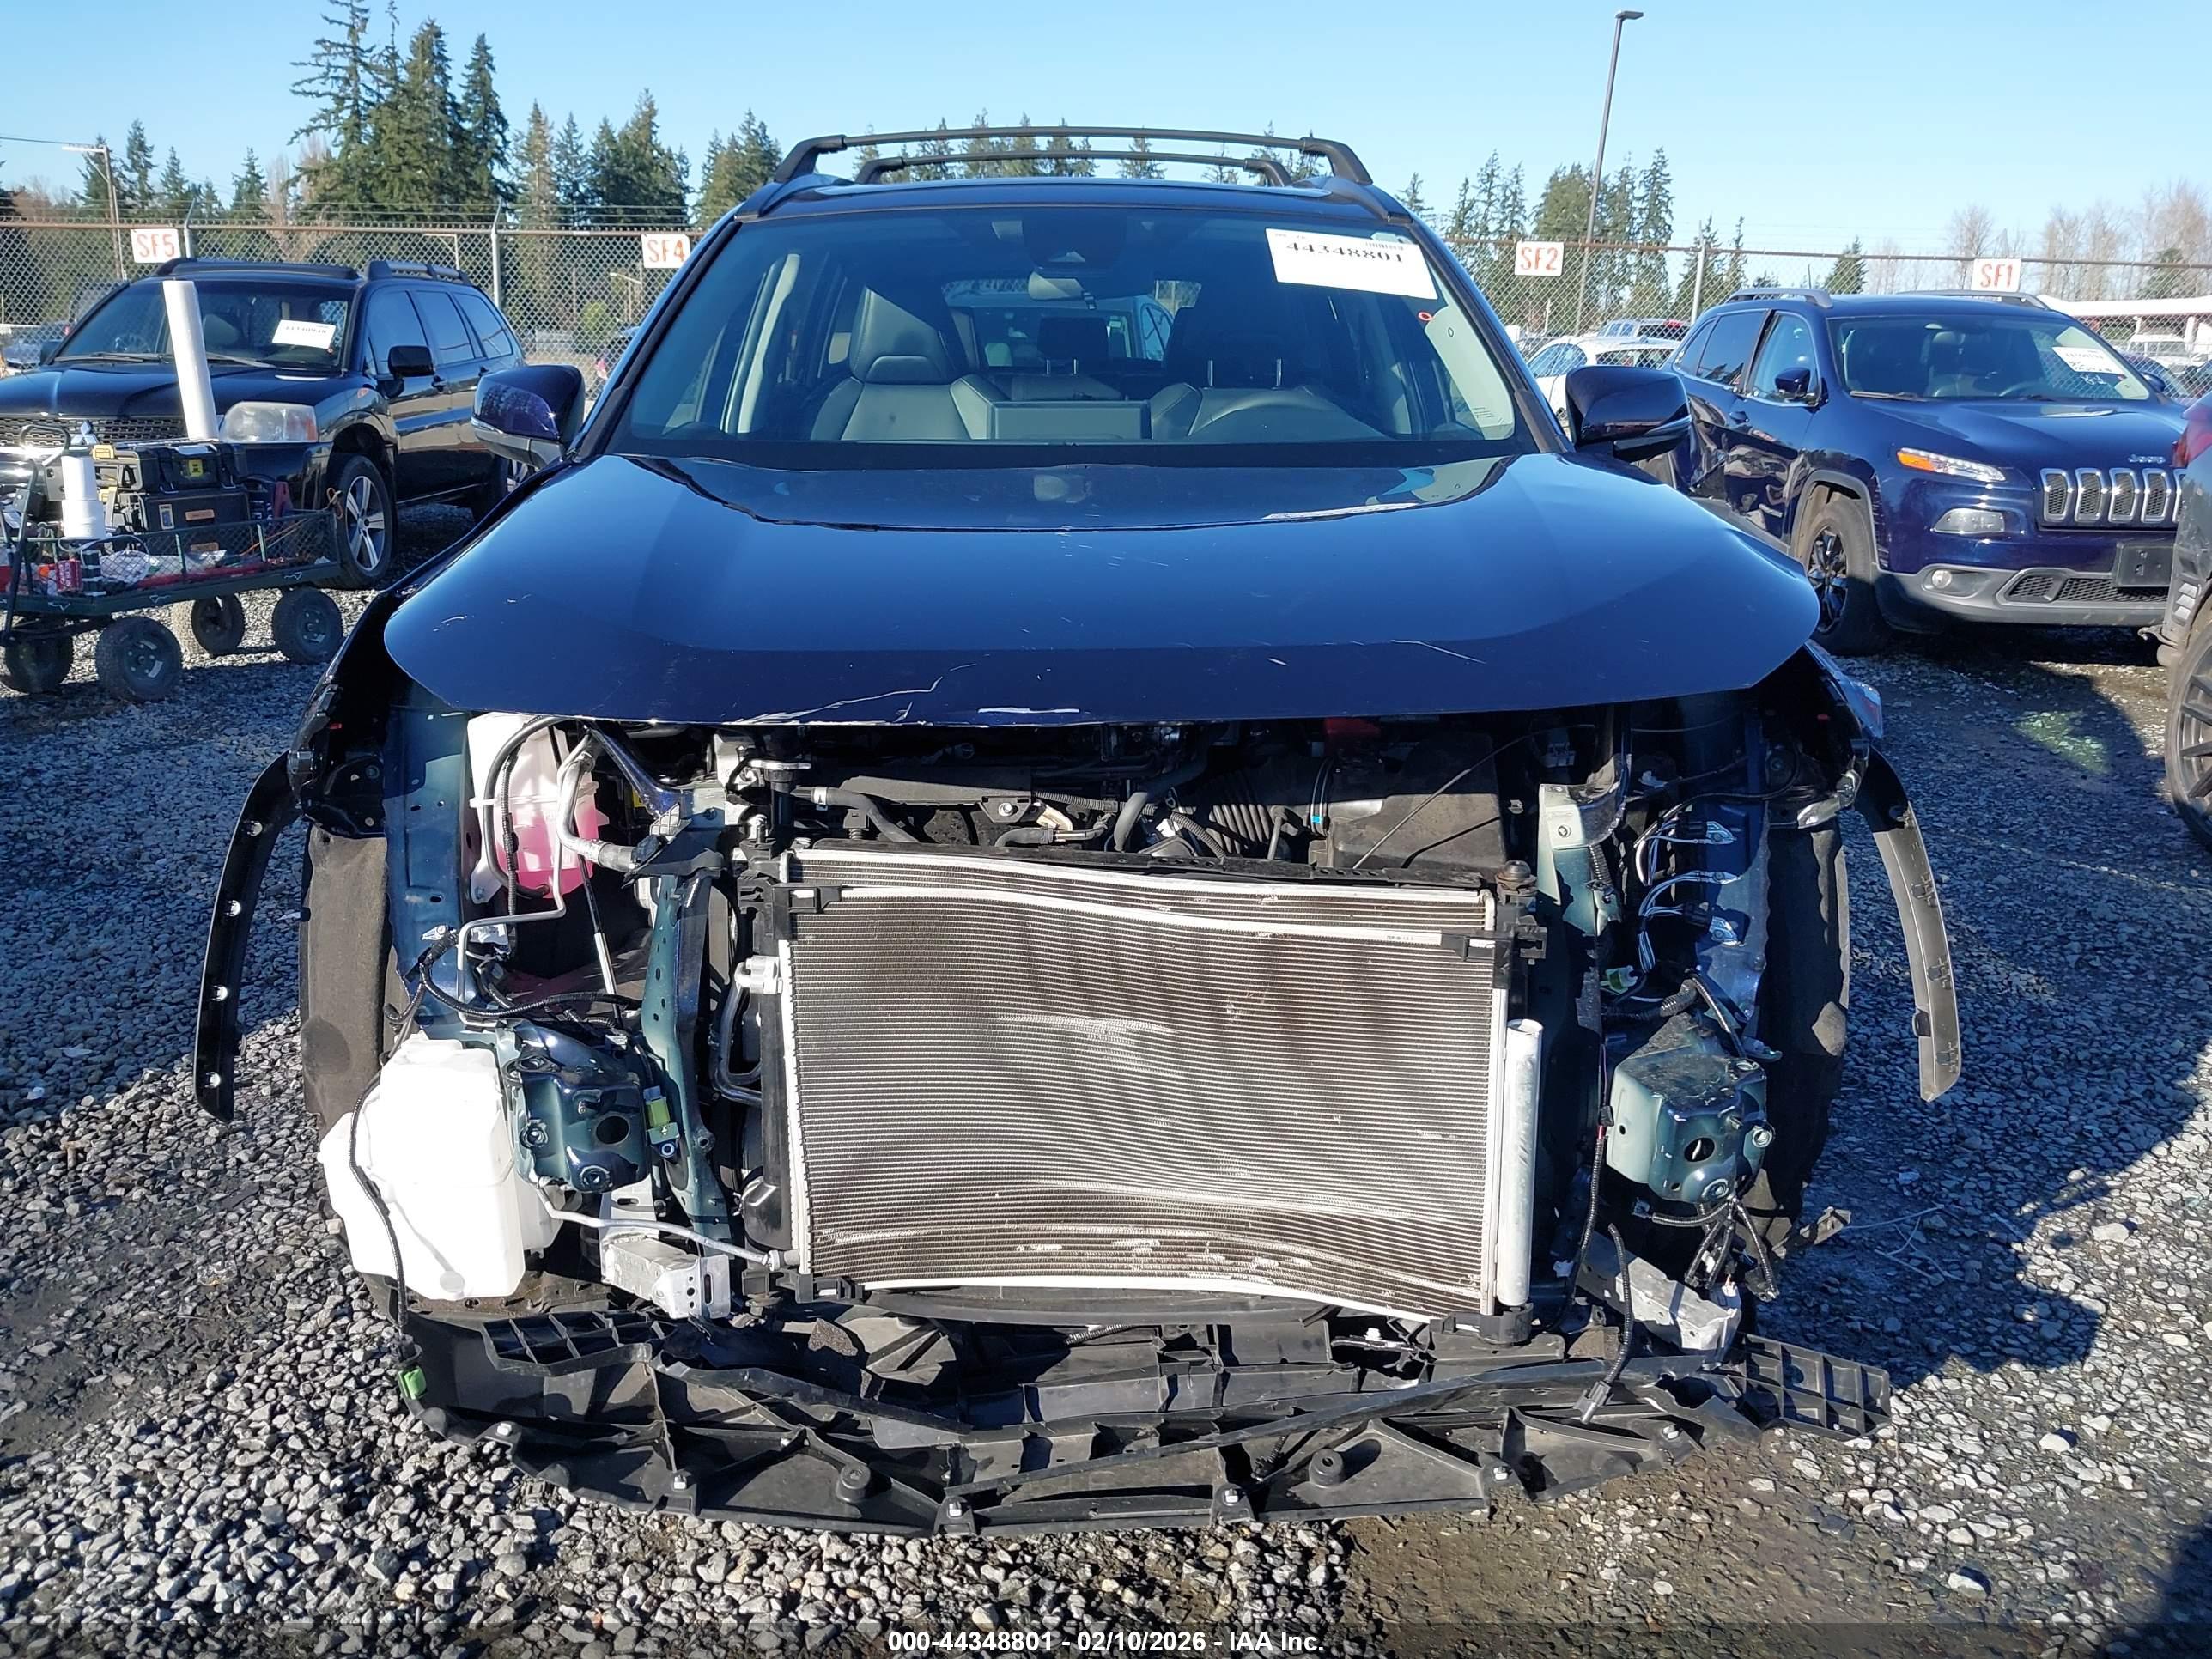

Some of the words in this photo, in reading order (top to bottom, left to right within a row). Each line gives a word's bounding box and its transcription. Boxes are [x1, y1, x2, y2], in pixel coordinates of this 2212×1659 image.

[137, 233, 174, 258] SF5
[647, 239, 685, 263] SF4
[1287, 242, 1402, 263] 44348801
[1520, 246, 1558, 270] SF2
[1979, 263, 2013, 288] SF1
